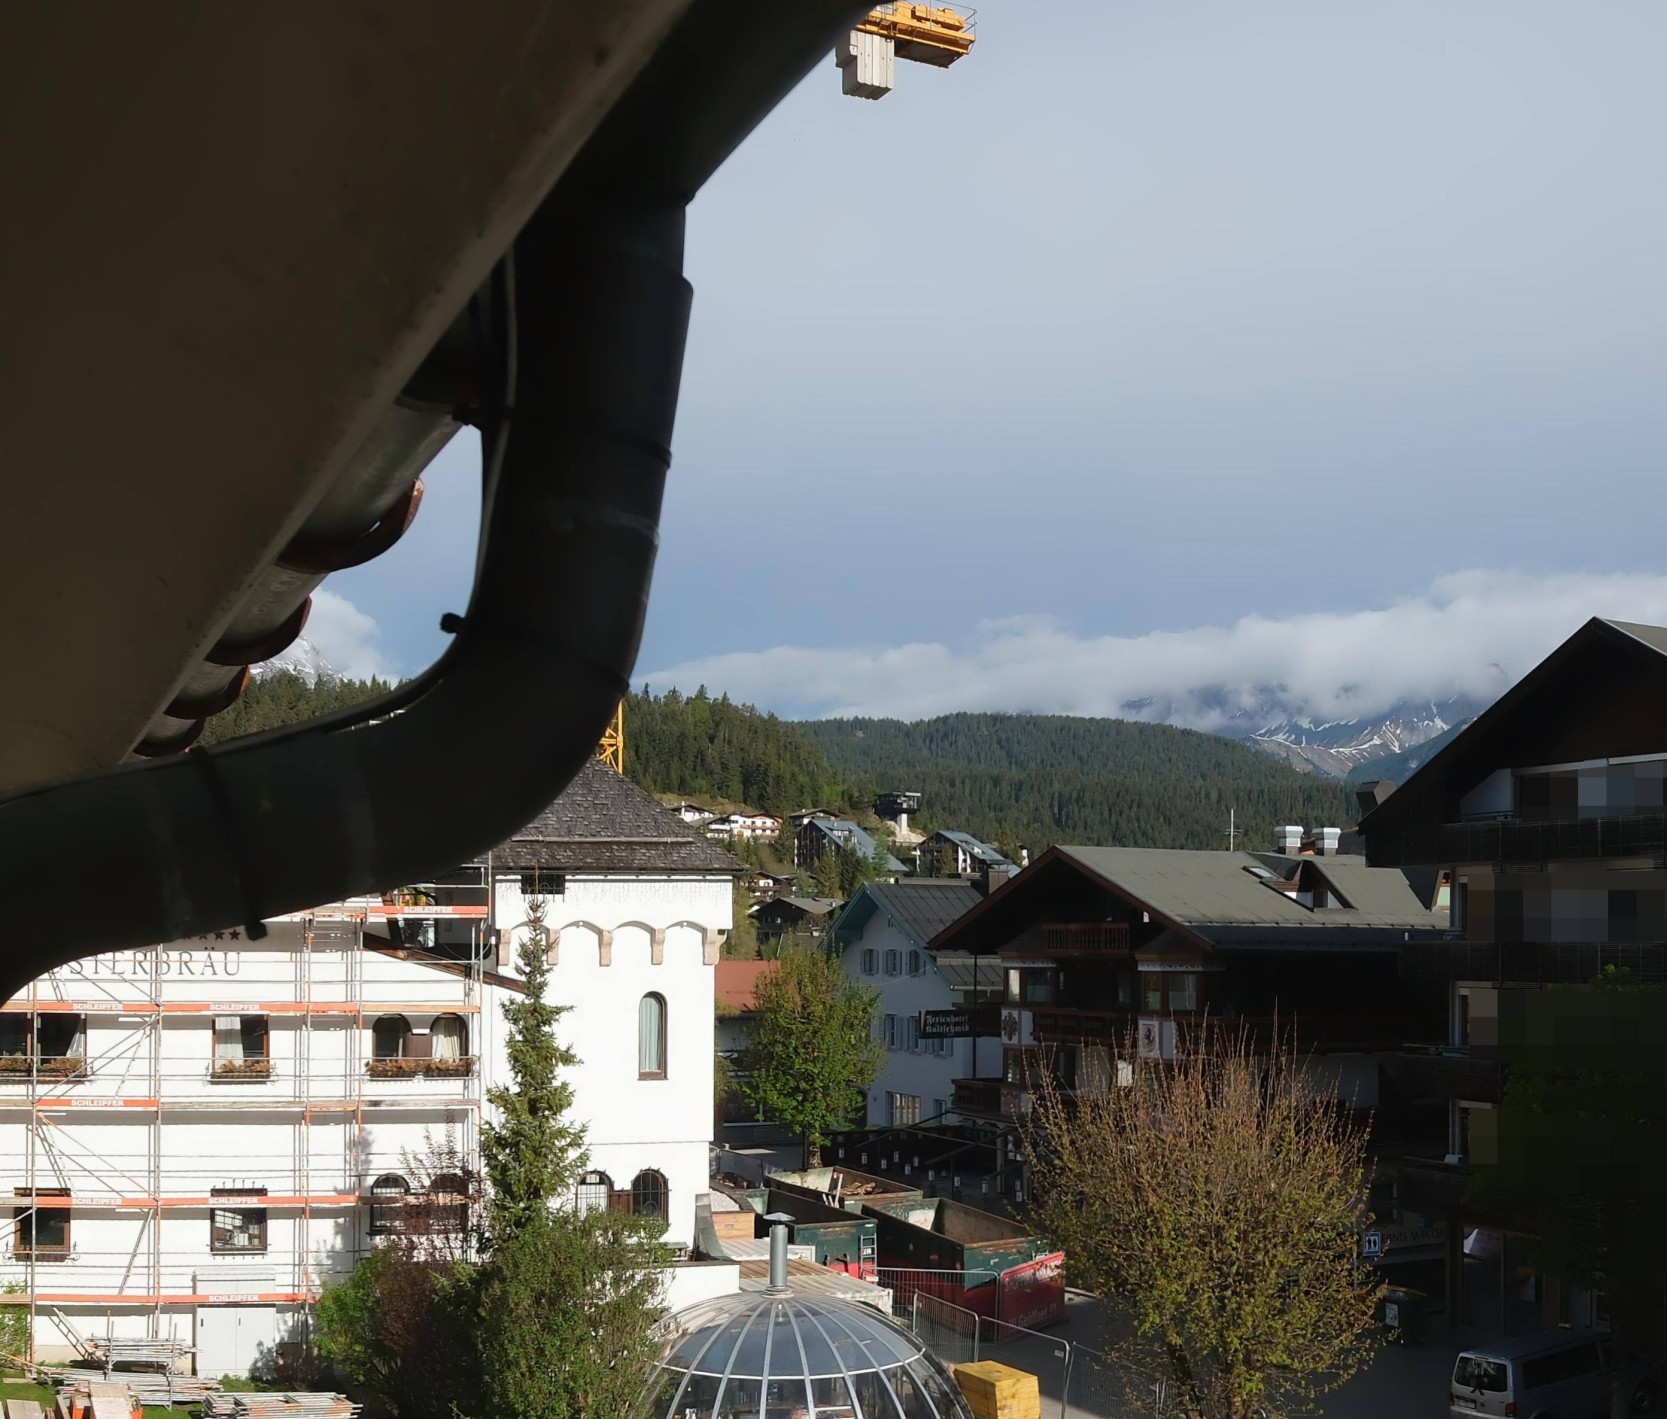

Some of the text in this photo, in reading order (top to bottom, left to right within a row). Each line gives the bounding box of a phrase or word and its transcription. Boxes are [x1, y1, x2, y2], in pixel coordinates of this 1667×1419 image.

[52, 946, 241, 976] STERBRÄU
[73, 1003, 123, 1011] SCHLEIPFER
[210, 1003, 260, 1011] SCHLEIPFER
